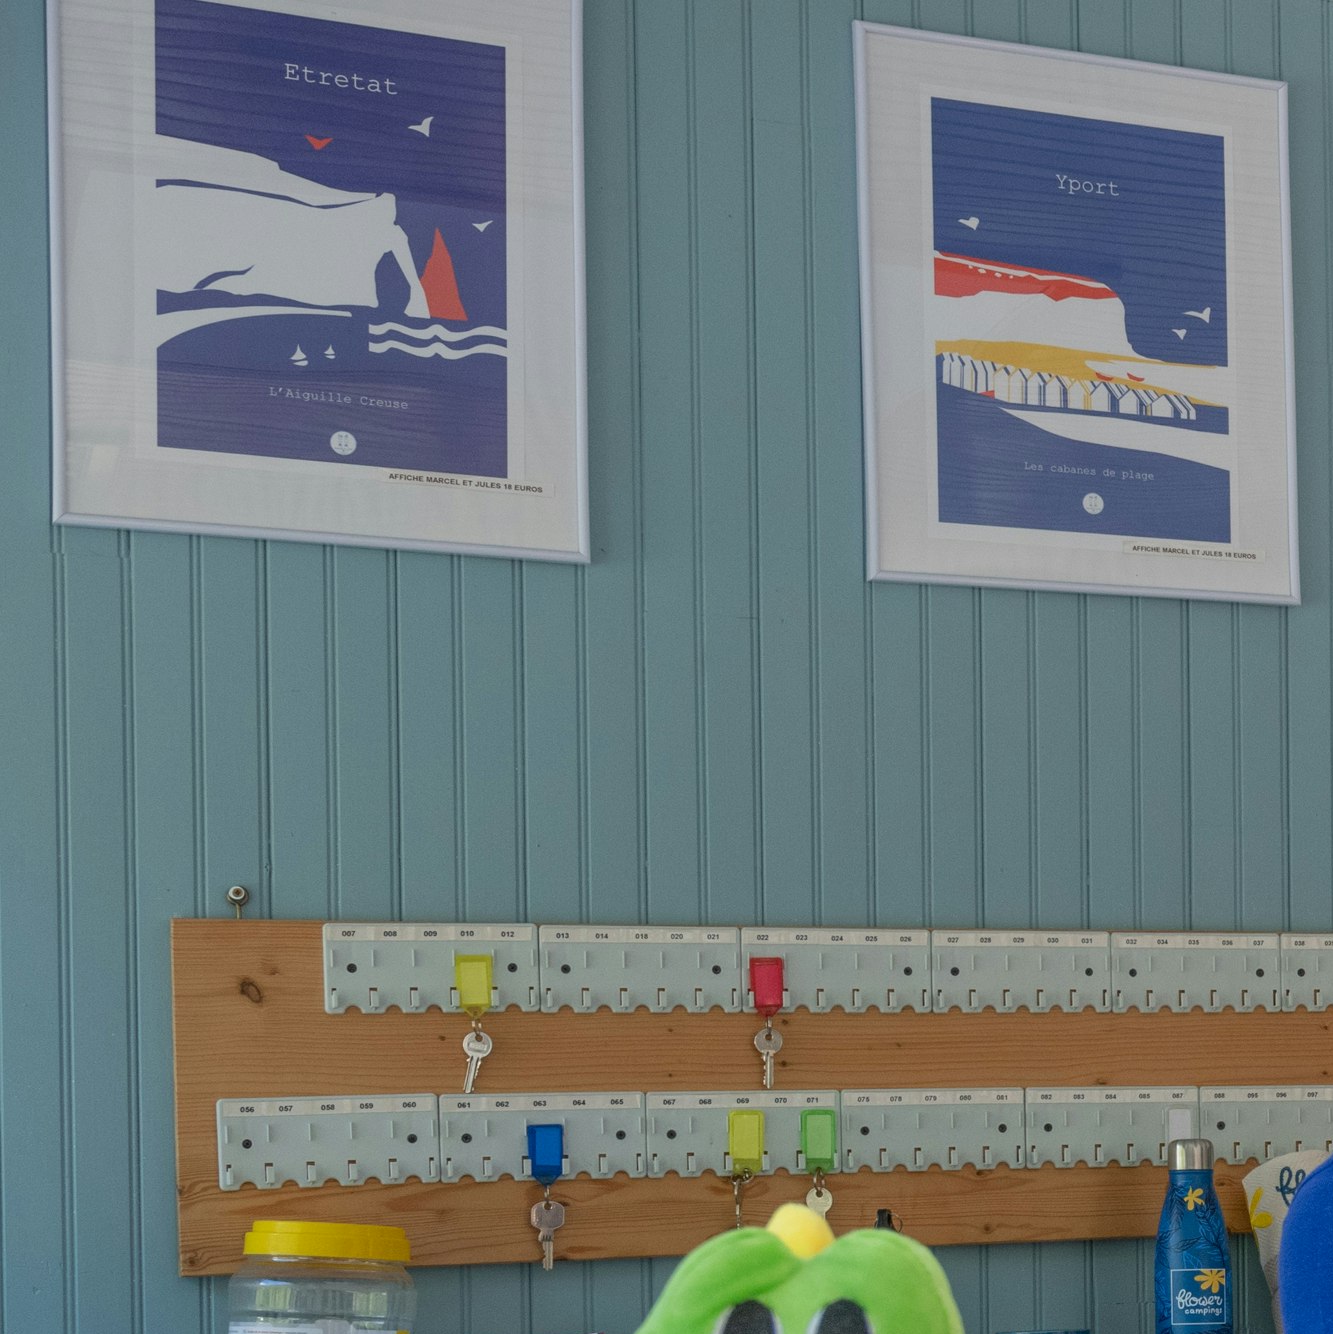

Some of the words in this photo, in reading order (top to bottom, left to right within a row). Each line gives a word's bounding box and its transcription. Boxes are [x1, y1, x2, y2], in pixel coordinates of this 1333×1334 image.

[285, 63, 397, 95] Etretat
[1056, 174, 1119, 196] Yport
[360, 396, 409, 410] Creuse
[1024, 462, 1044, 472] Les
[1050, 464, 1097, 476] cabanes
[1103, 468, 1116, 478] de
[1122, 469, 1155, 481] plage
[388, 472, 424, 483] AFFICHE
[426, 476, 460, 486] MARCEL
[462, 479, 472, 487] ET
[474, 480, 501, 489] JULES
[504, 482, 512, 490] 18
[514, 484, 543, 493] EUROS
[1132, 545, 1161, 554] AFFICHE
[1162, 546, 1190, 555] MARCEL
[1201, 550, 1223, 558] JULES
[1233, 552, 1257, 560] EUROS
[341, 930, 356, 939] 007
[383, 930, 398, 939] 008
[423, 930, 438, 939] 009
[460, 930, 475, 939] 010
[500, 930, 515, 939] 012
[555, 932, 570, 941] 013
[594, 932, 609, 941] 014
[670, 933, 684, 941] 020
[706, 933, 720, 942] 021
[756, 934, 769, 942] 022
[795, 934, 808, 942] 023
[830, 935, 844, 943] 024
[864, 935, 878, 943] 025
[899, 935, 913, 944] 026
[947, 937, 959, 945] 027
[1012, 937, 1025, 945] 029
[1046, 937, 1060, 945] 030
[1081, 937, 1093, 945] 031
[1125, 938, 1138, 946] 032
[1156, 938, 1169, 946] 034
[1187, 938, 1200, 947] 035
[1221, 939, 1234, 947] 036
[1252, 939, 1265, 947] 037
[857, 1096, 871, 1104] 075
[924, 1094, 938, 1103] 079
[1040, 1093, 1053, 1101] 082
[1104, 1093, 1117, 1101] 084
[1138, 1093, 1151, 1101] 085
[1171, 1092, 1184, 1100] 087
[1306, 1091, 1319, 1099] 097
[457, 1102, 471, 1111] 061
[495, 1100, 510, 1110] 062
[532, 1099, 548, 1108] 063
[572, 1099, 586, 1107] 064
[610, 1098, 624, 1107] 065
[662, 1098, 676, 1107] 067
[698, 1098, 713, 1107] 068
[736, 1097, 750, 1106] 069
[774, 1097, 788, 1105] 070
[806, 1096, 819, 1105] 071
[239, 1105, 255, 1115] 056
[278, 1105, 294, 1114] 057
[320, 1103, 336, 1112] 058
[359, 1102, 374, 1111] 059
[402, 1101, 417, 1110] 060
[1176, 1289, 1222, 1309] flower
[1185, 1306, 1222, 1316] campings
